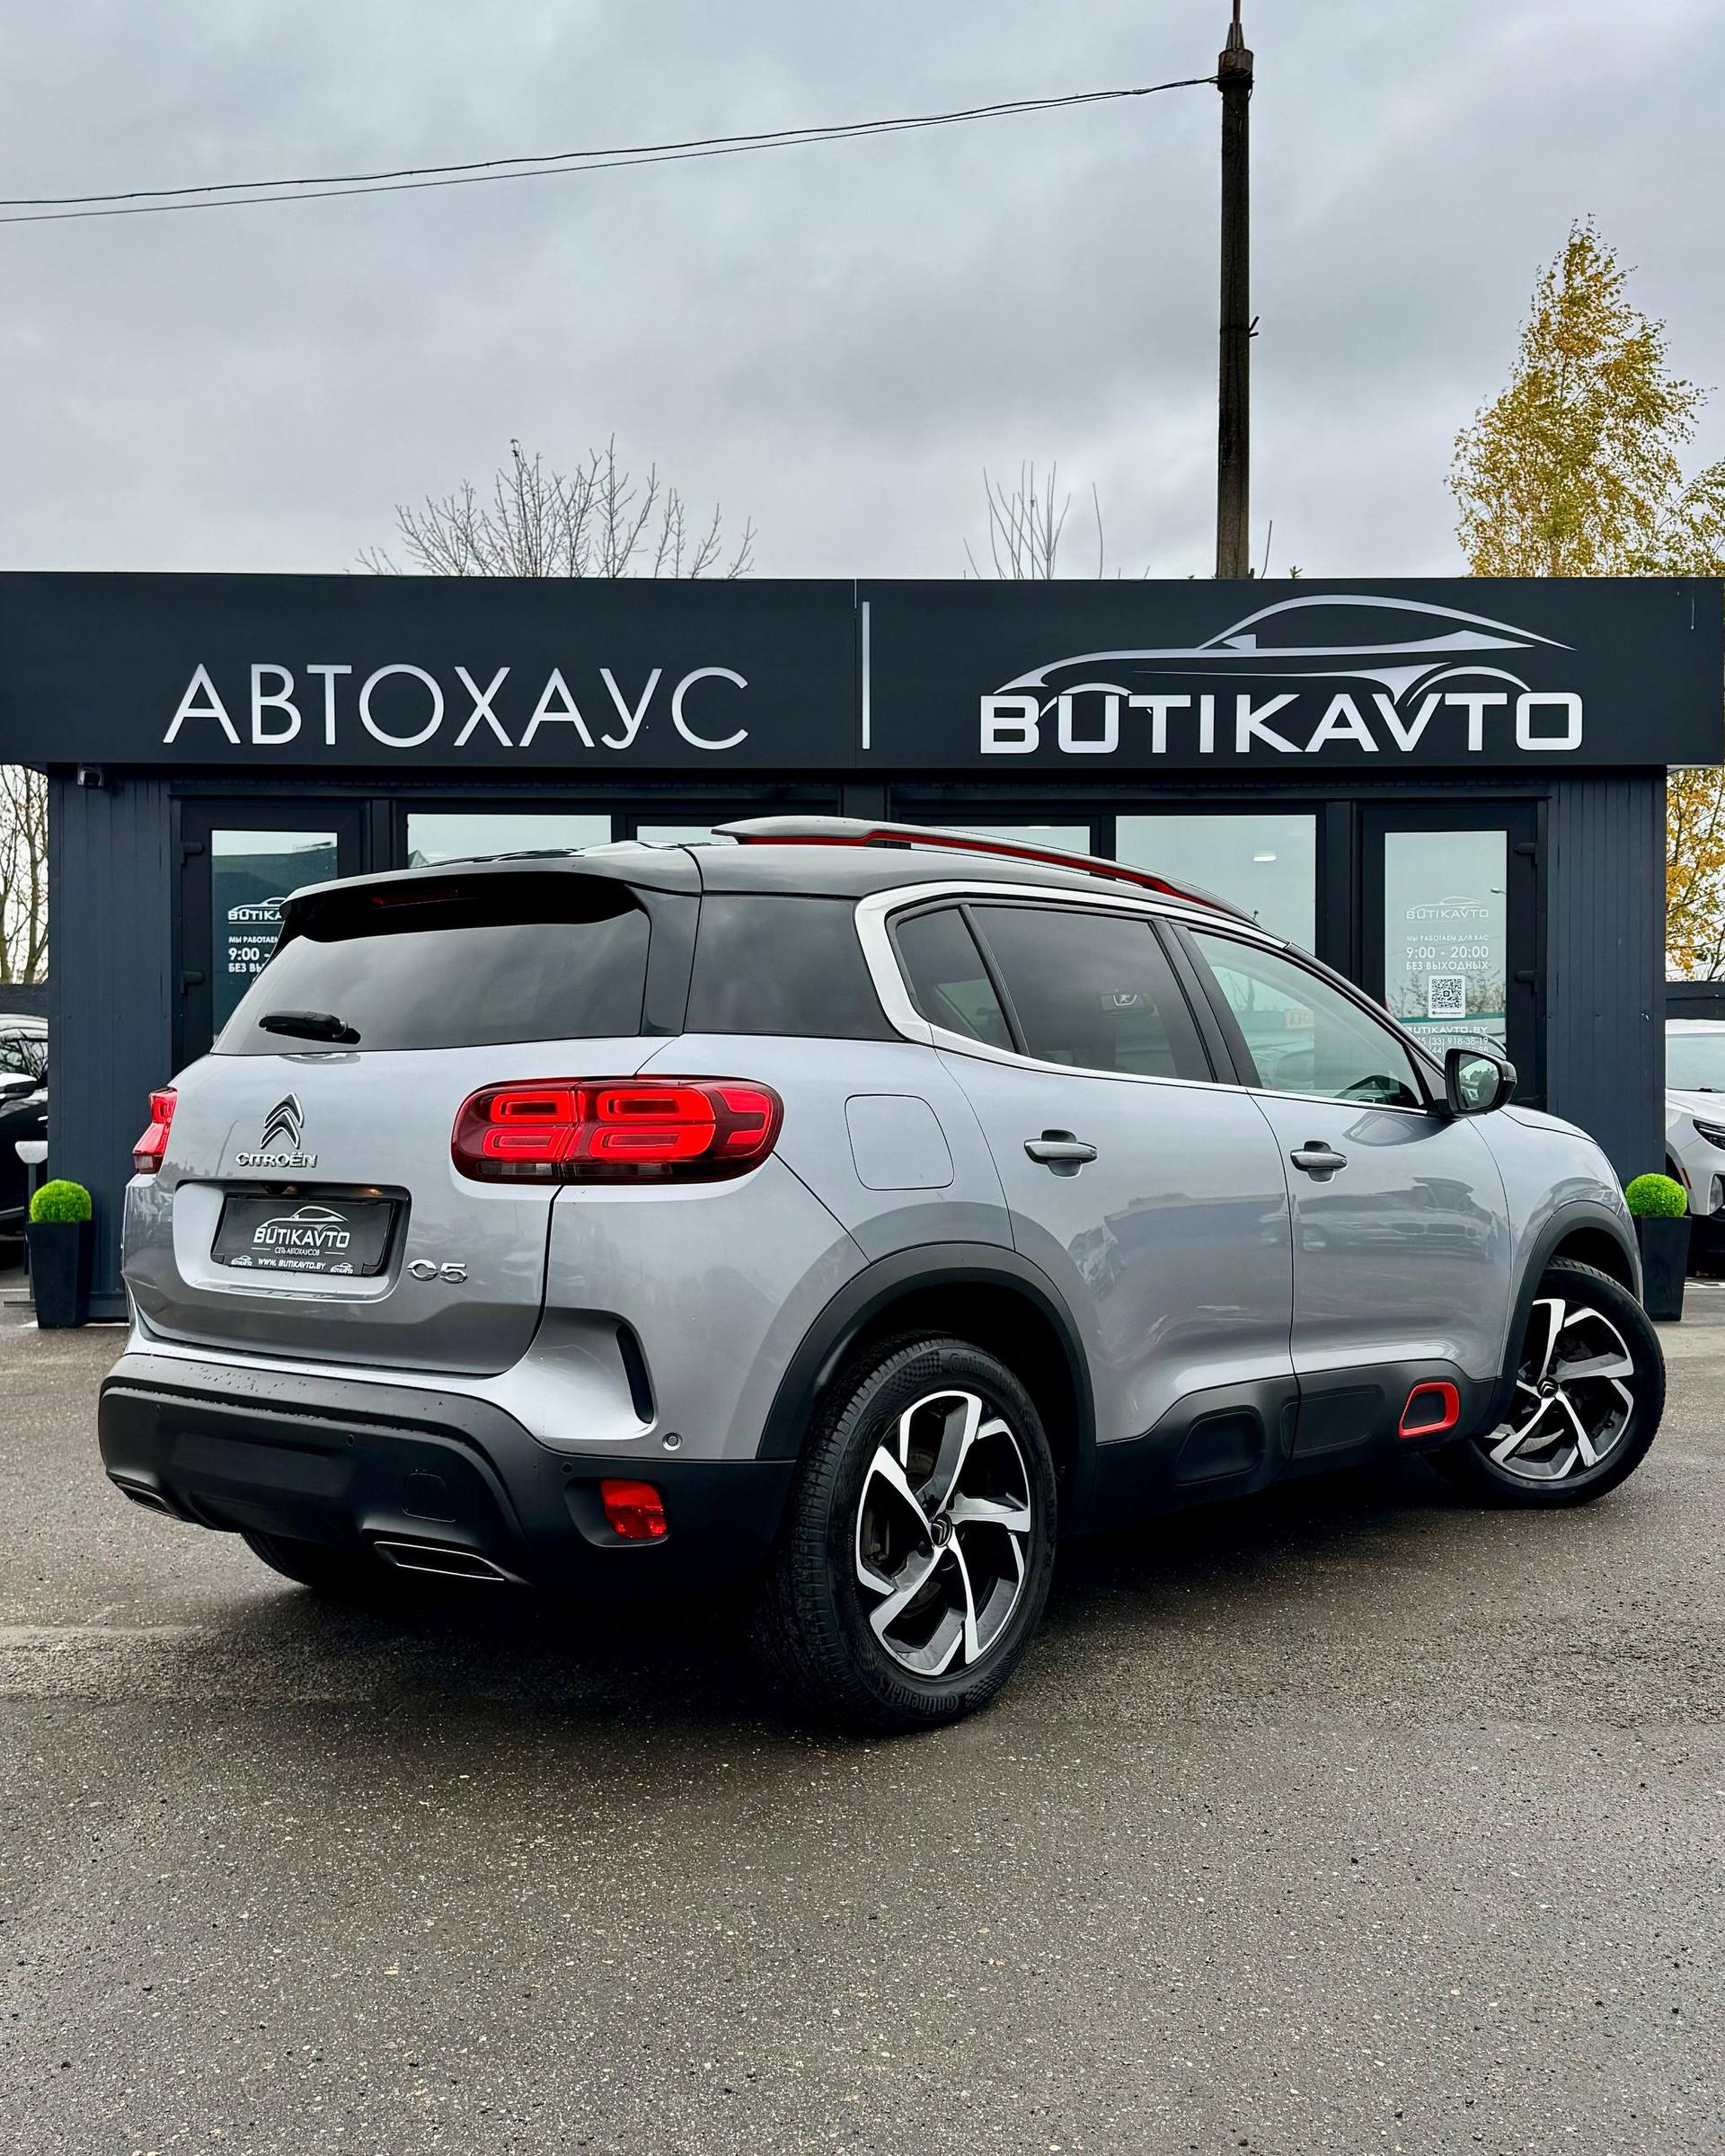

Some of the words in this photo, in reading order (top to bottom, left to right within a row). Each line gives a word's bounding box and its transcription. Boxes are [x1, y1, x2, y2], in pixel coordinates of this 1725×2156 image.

[163, 663, 750, 751] АВТОХАУС
[979, 691, 1583, 755] BUTIKAVTO
[1405, 908, 1489, 920] BUTIKAVTO
[1406, 934, 1419, 942] МЫ
[1420, 934, 1457, 942] РАБОТАЕМ
[1457, 934, 1473, 942] ДЛЯ
[1473, 933, 1489, 941] ВАС
[228, 948, 260, 960] 9:00
[1405, 946, 1436, 959] 9:00
[1450, 945, 1489, 959] 20:00
[228, 962, 247, 973] БЕЗ
[1406, 960, 1423, 971] БЕЗ
[1426, 960, 1489, 971] ВЫХОДНЫХ
[1430, 1037, 1445, 1046] (33)
[1447, 1036, 1489, 1046] 918-38-19
[235, 1151, 318, 1168] CITROËN
[253, 1227, 350, 1248] BUTIKAVTO
[406, 1258, 468, 1285] C5
